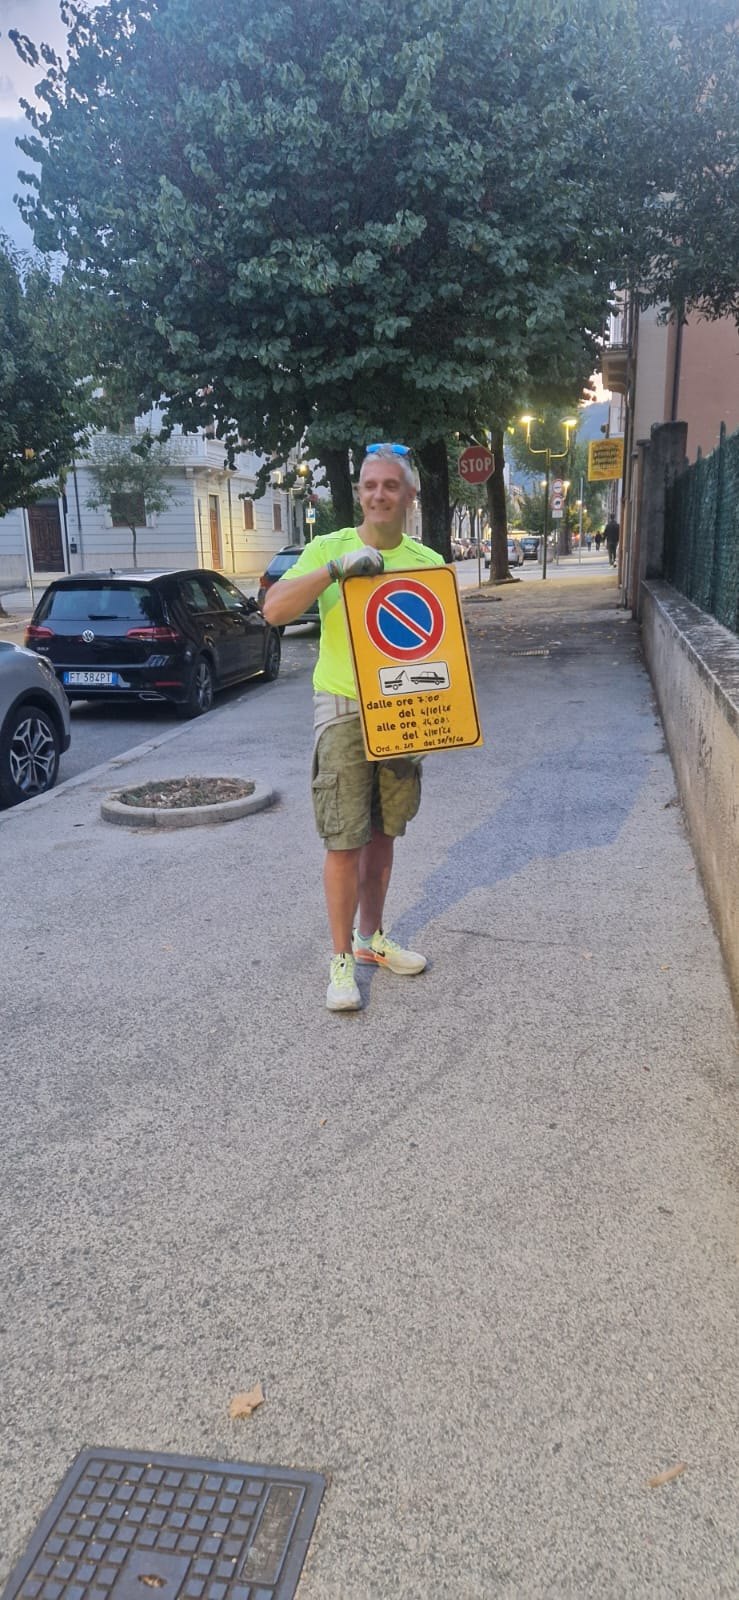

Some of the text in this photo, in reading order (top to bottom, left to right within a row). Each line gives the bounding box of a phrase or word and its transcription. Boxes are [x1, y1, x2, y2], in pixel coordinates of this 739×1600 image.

[460, 458, 492, 474] STOP
[70, 672, 110, 682] FT 384PT
[366, 699, 392, 710] dalle
[396, 698, 413, 707] ore
[398, 709, 415, 718] del
[376, 721, 396, 732] alle
[400, 720, 417, 729] ore
[402, 730, 419, 741] del
[375, 744, 392, 753] Ord.
[423, 739, 436, 748] del
